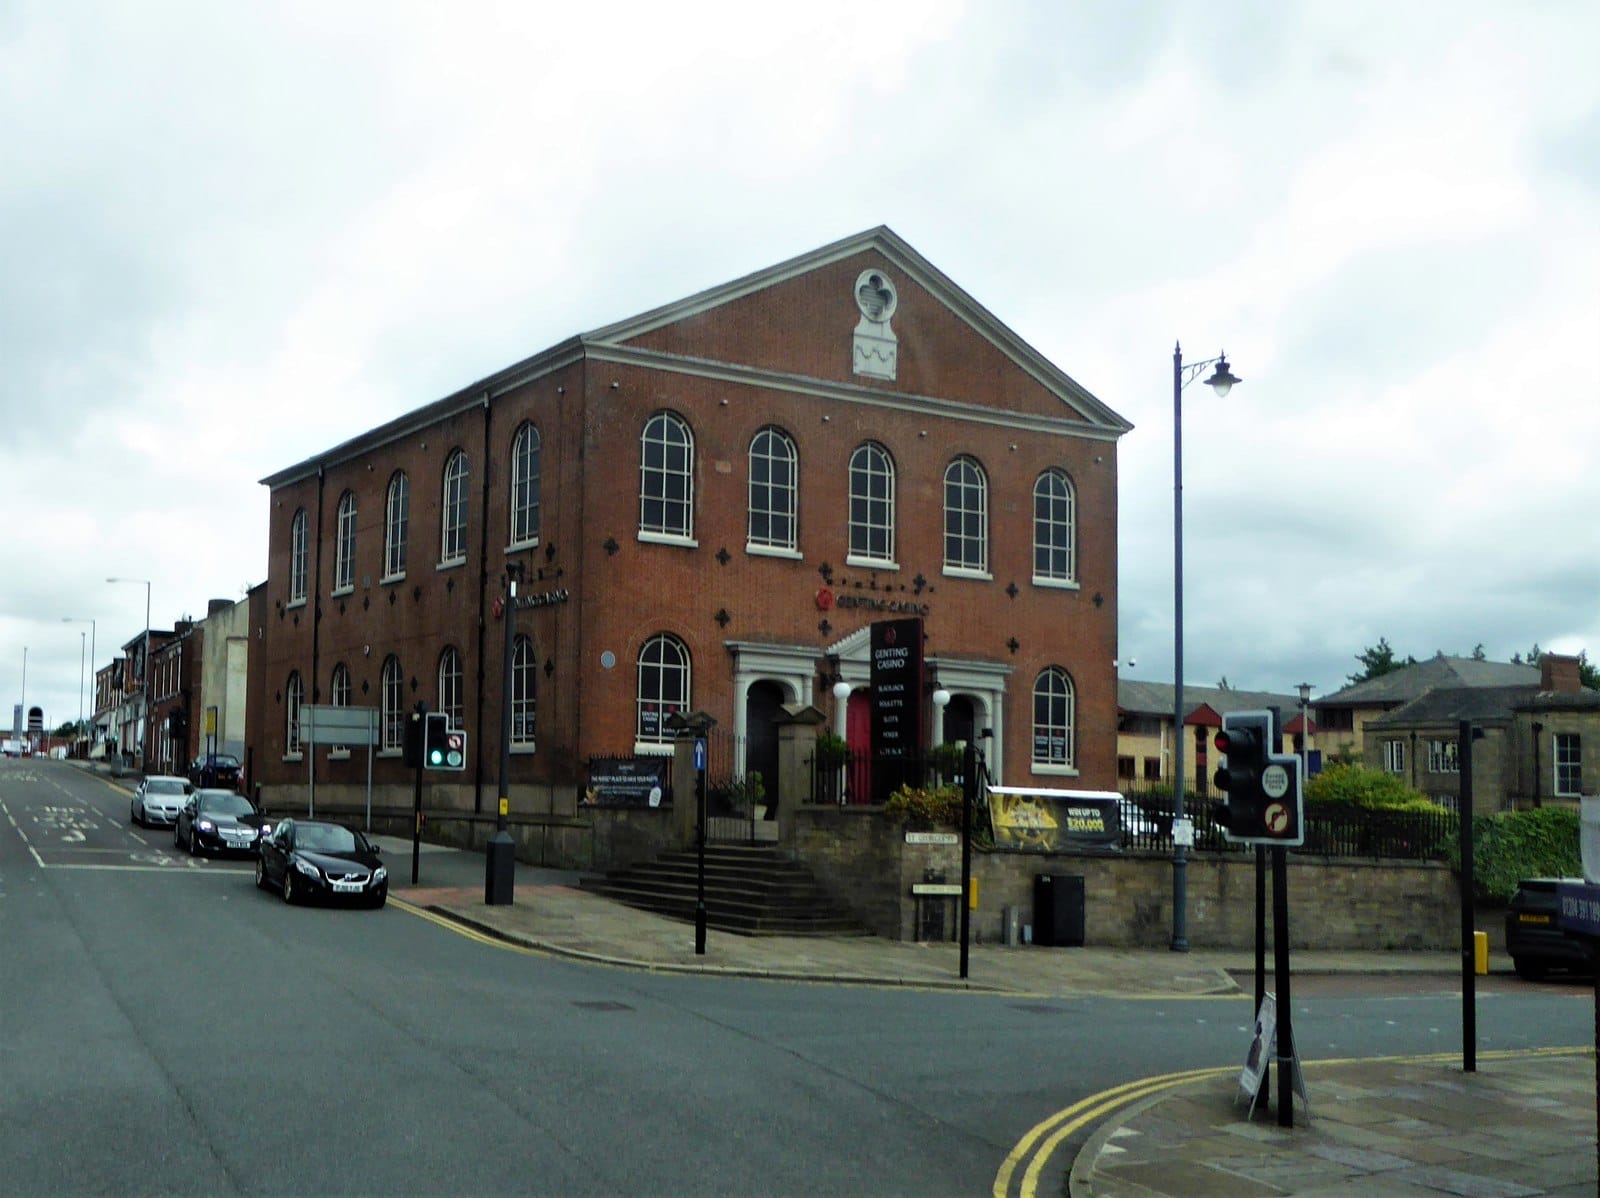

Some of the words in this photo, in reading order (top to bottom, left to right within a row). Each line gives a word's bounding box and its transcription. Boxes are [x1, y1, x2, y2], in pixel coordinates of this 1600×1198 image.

[875, 647, 909, 659] GENTING
[877, 658, 905, 670] CASINO
[1067, 807, 1081, 816] WIN
[1081, 808, 1091, 817] UP
[1090, 808, 1101, 817] TO
[1067, 817, 1105, 832] £20,000
